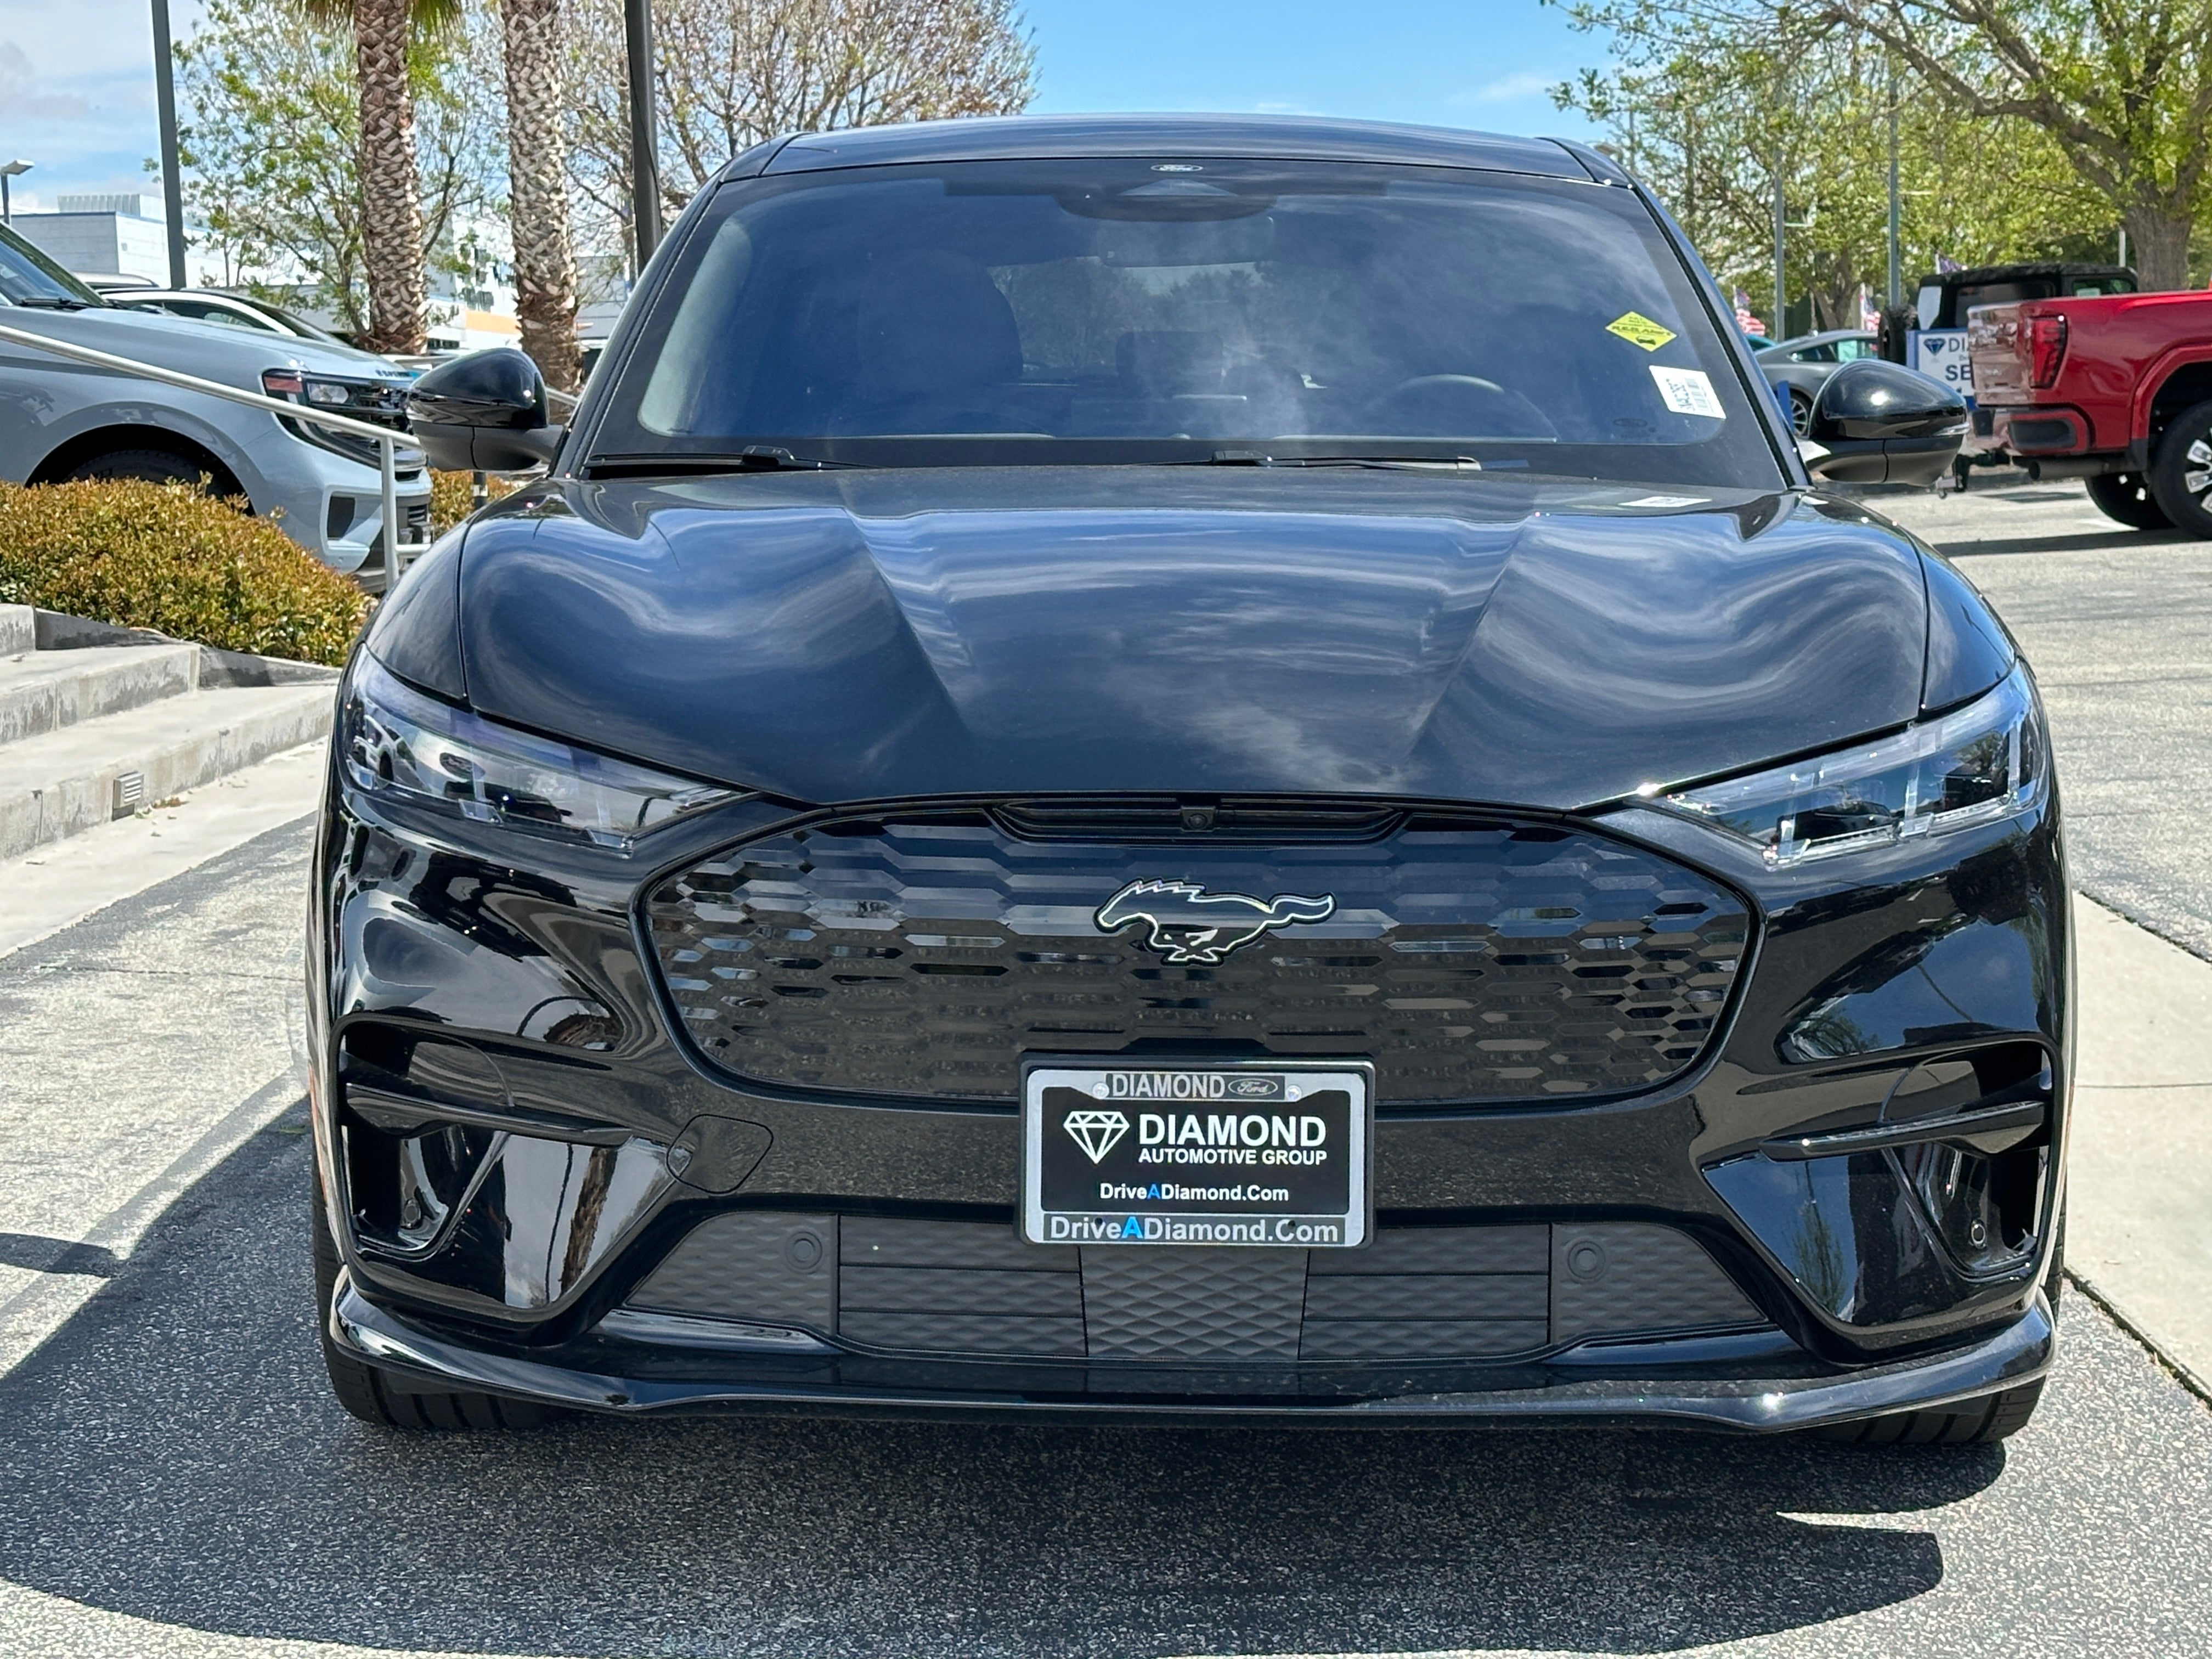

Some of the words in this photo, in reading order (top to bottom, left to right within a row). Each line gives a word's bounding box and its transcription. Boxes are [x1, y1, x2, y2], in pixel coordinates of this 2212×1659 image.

[1949, 337, 1969, 352] DI
[1112, 1074, 1225, 1098] DIAMOND
[1237, 1080, 1268, 1093] Ford
[1139, 1114, 1327, 1147] DIAMOND
[1138, 1148, 1257, 1164] AUTOMOTIVE
[1262, 1149, 1327, 1165] GROUP
[1100, 1183, 1289, 1201] DriveADiamond.Com
[1051, 1216, 1338, 1242] DriveADiamond.Com
